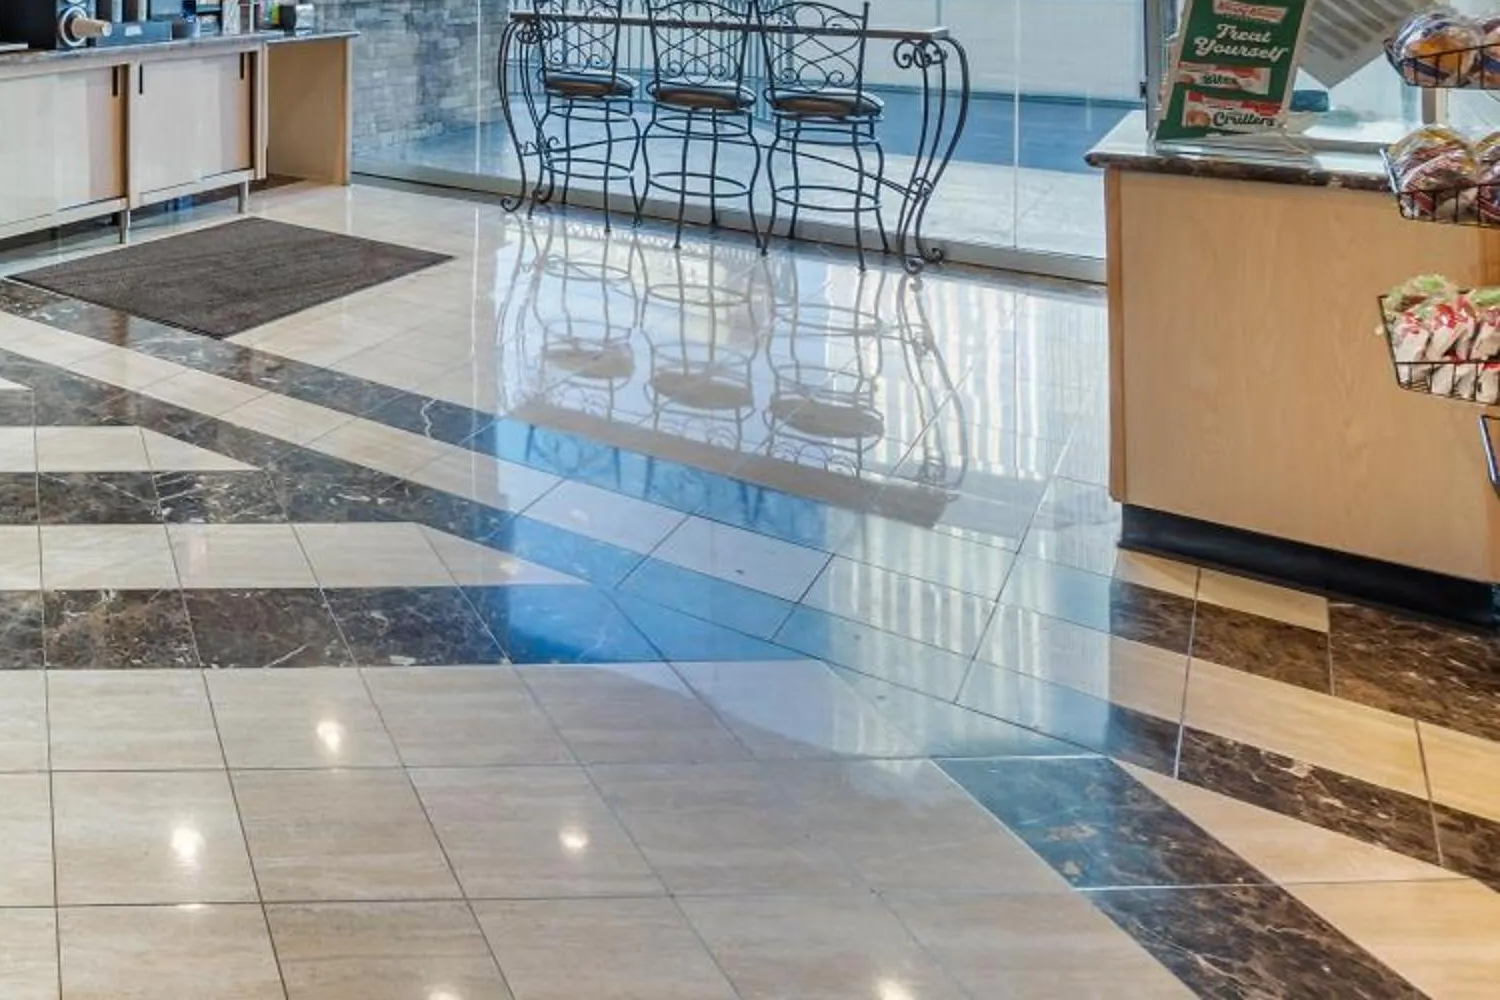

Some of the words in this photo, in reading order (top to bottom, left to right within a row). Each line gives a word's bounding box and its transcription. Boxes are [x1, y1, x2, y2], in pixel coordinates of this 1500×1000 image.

[1215, 24, 1272, 43] Treat
[1194, 36, 1288, 62] Yourself
[1213, 111, 1275, 127] Crullers
